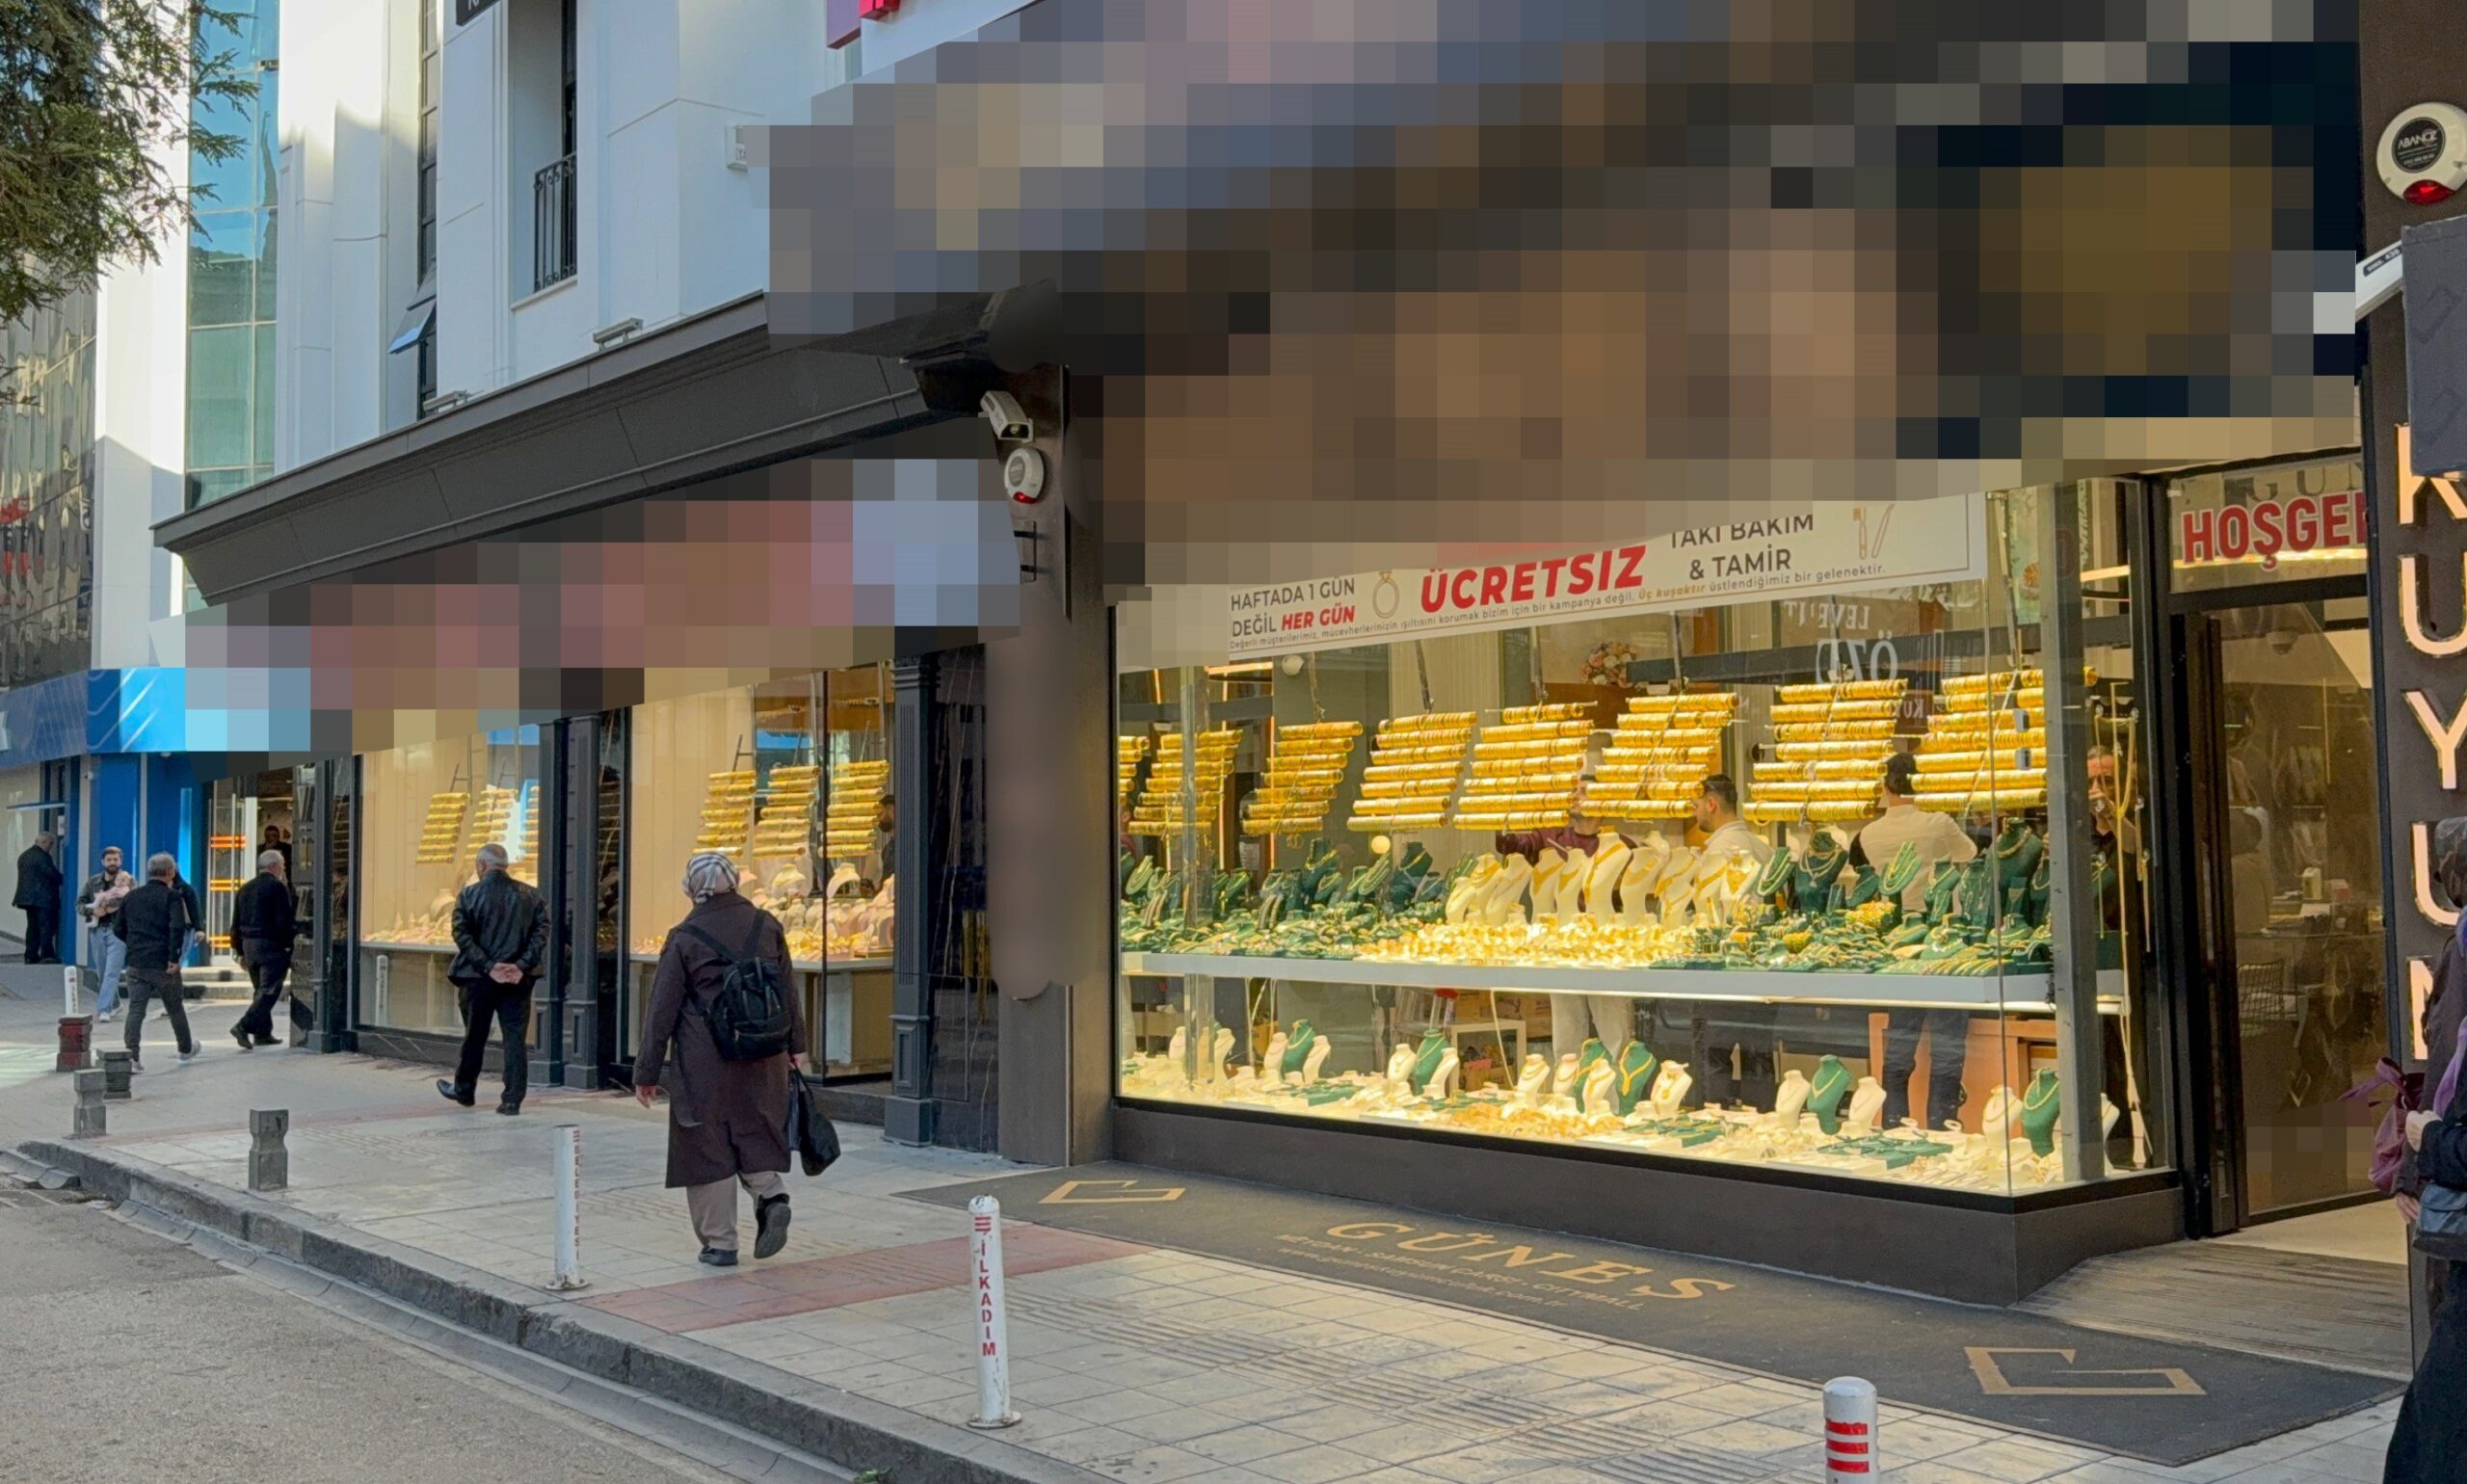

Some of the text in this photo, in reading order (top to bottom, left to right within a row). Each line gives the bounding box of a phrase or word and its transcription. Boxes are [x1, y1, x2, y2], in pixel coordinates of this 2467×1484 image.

[1689, 543, 1791, 580] & TAMİR
[1231, 575, 1355, 611] HAFTADA 1 GÜN
[1439, 612, 1479, 624] korumak
[1482, 607, 1509, 619] bizim
[1511, 605, 1529, 616] için
[1533, 602, 1546, 613] bir
[1550, 596, 1602, 610] kampanya
[1710, 573, 1791, 592] üstlendiğimiz
[1794, 570, 1812, 583] bir
[1233, 602, 1356, 637] DEĞİL HER GÜN
